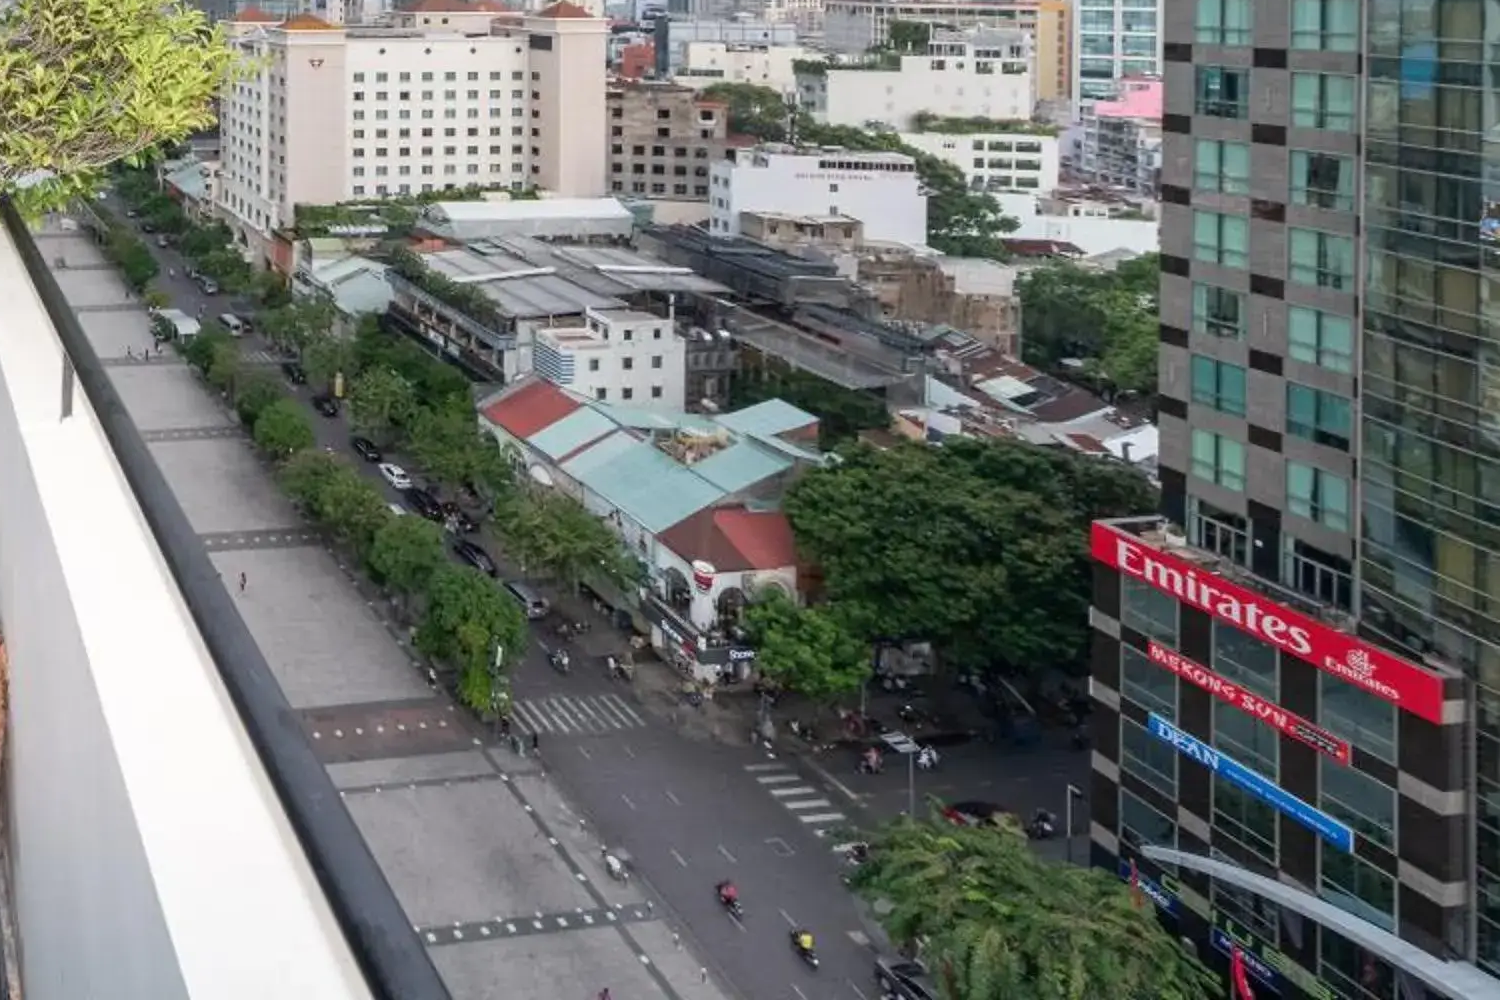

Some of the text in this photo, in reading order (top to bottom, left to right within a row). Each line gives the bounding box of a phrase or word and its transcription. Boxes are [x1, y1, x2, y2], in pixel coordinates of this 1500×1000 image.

[1116, 538, 1312, 655] Emirates
[1150, 645, 1288, 728] MEKONG SUN
[1324, 655, 1400, 700] Emirates
[1157, 722, 1220, 770] DEAN
